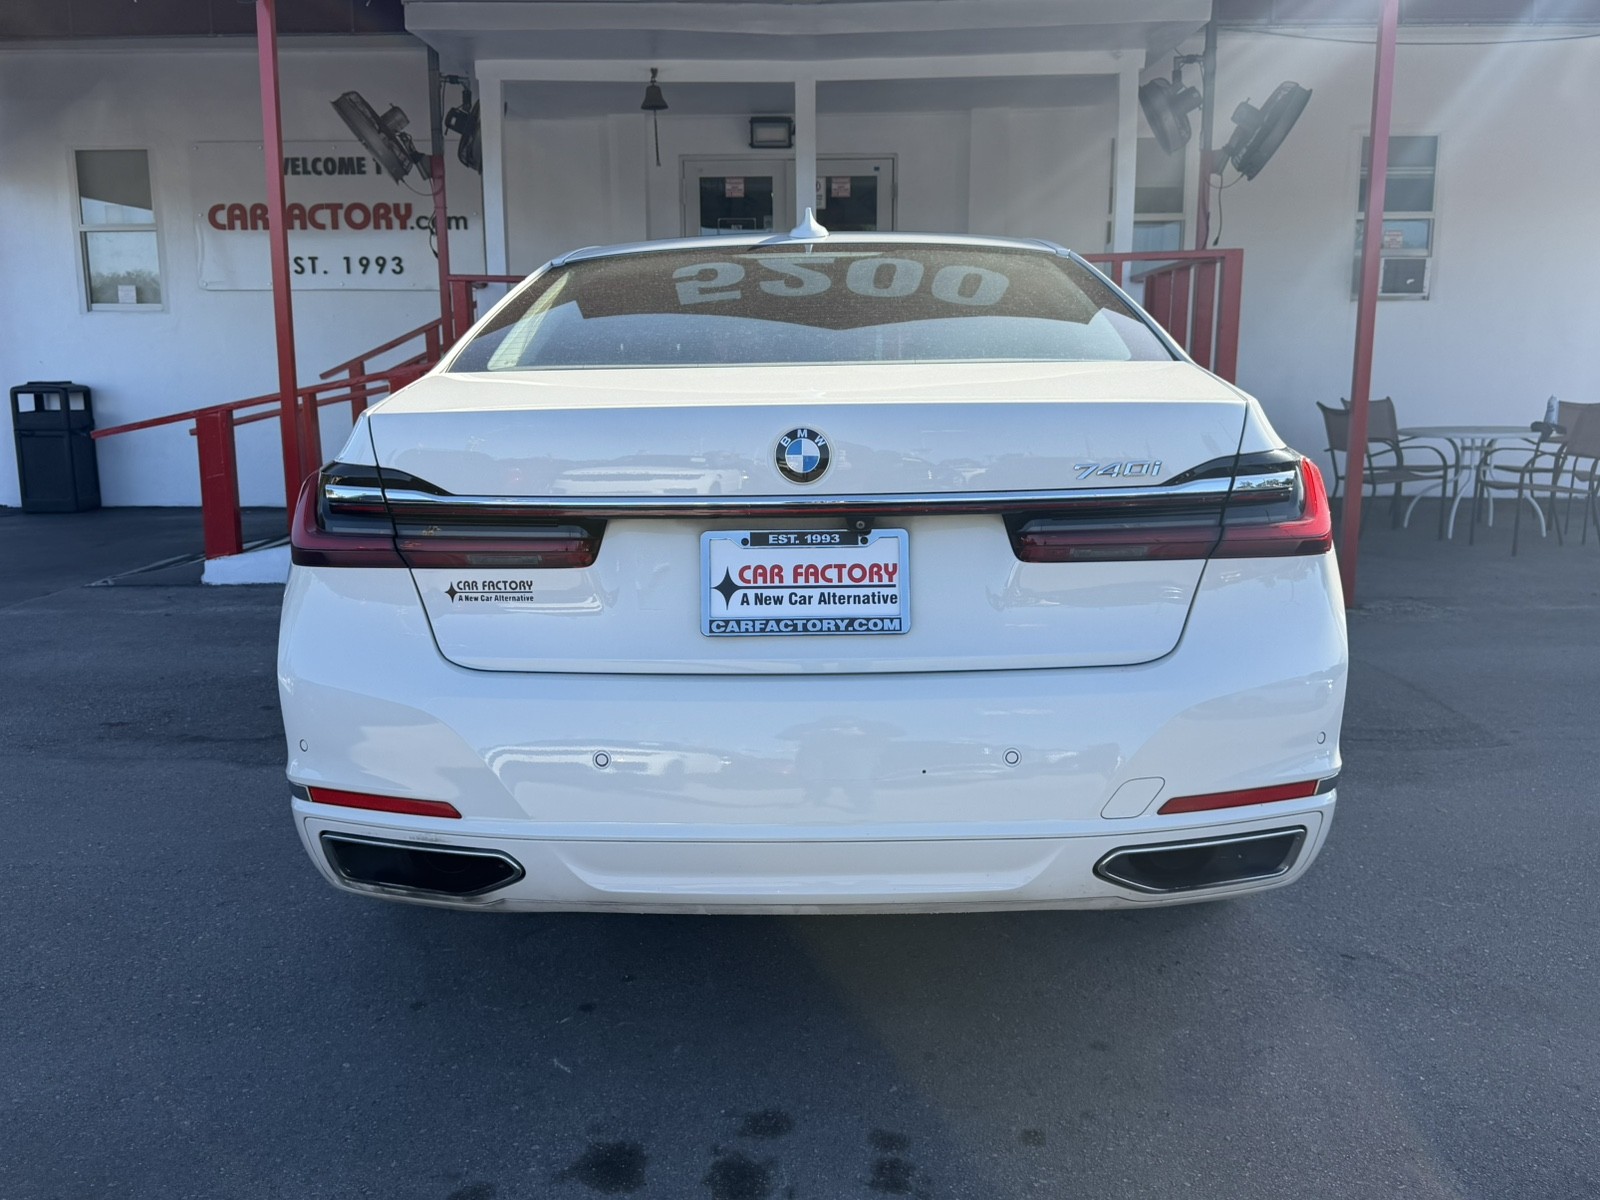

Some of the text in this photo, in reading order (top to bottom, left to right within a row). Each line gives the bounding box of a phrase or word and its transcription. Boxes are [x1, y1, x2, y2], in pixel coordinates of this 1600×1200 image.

[207, 203, 469, 231] CARACTORY.cm
[293, 256, 405, 275] ST. 1993
[780, 429, 827, 447] BMW
[1074, 461, 1162, 480] 740i
[768, 533, 841, 545] EST. 1993
[738, 563, 898, 585] CAR FACTORY
[456, 580, 534, 591] CAR FACTORY
[480, 594, 493, 602] Car
[494, 593, 534, 602] Alternative
[740, 591, 898, 606] A New Car Alternative
[710, 618, 901, 633] CARFACTORY.COM
